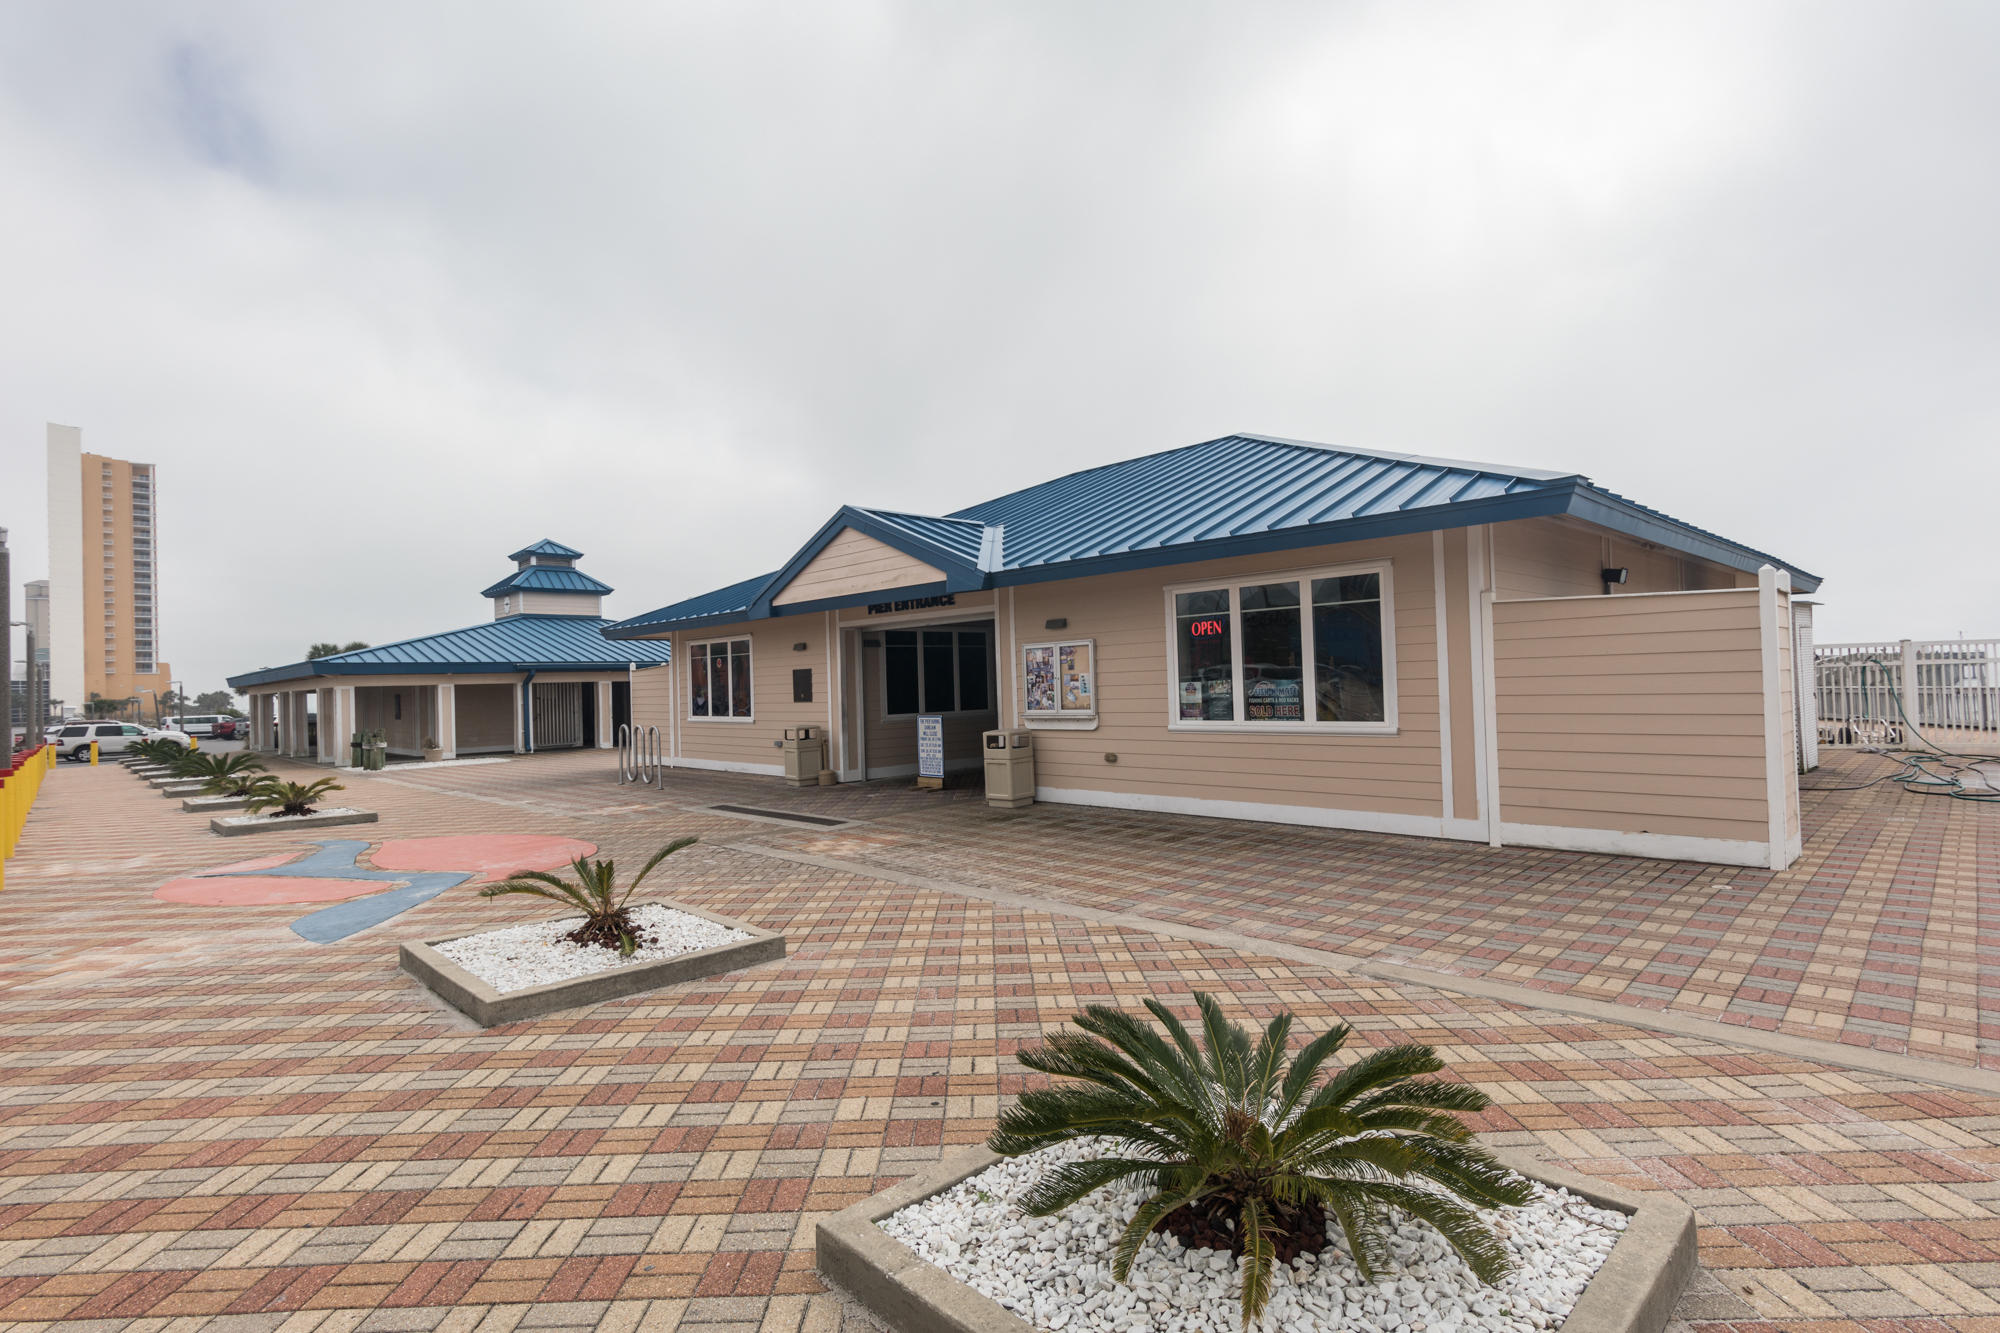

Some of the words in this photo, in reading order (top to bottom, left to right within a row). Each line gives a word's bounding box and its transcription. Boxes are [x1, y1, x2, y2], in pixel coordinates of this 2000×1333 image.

[868, 602, 892, 615] PIER
[894, 593, 956, 611] ENTRANCE
[1191, 620, 1222, 636] OPEN
[1249, 704, 1273, 717] SOLD
[1275, 704, 1300, 717] HERE
